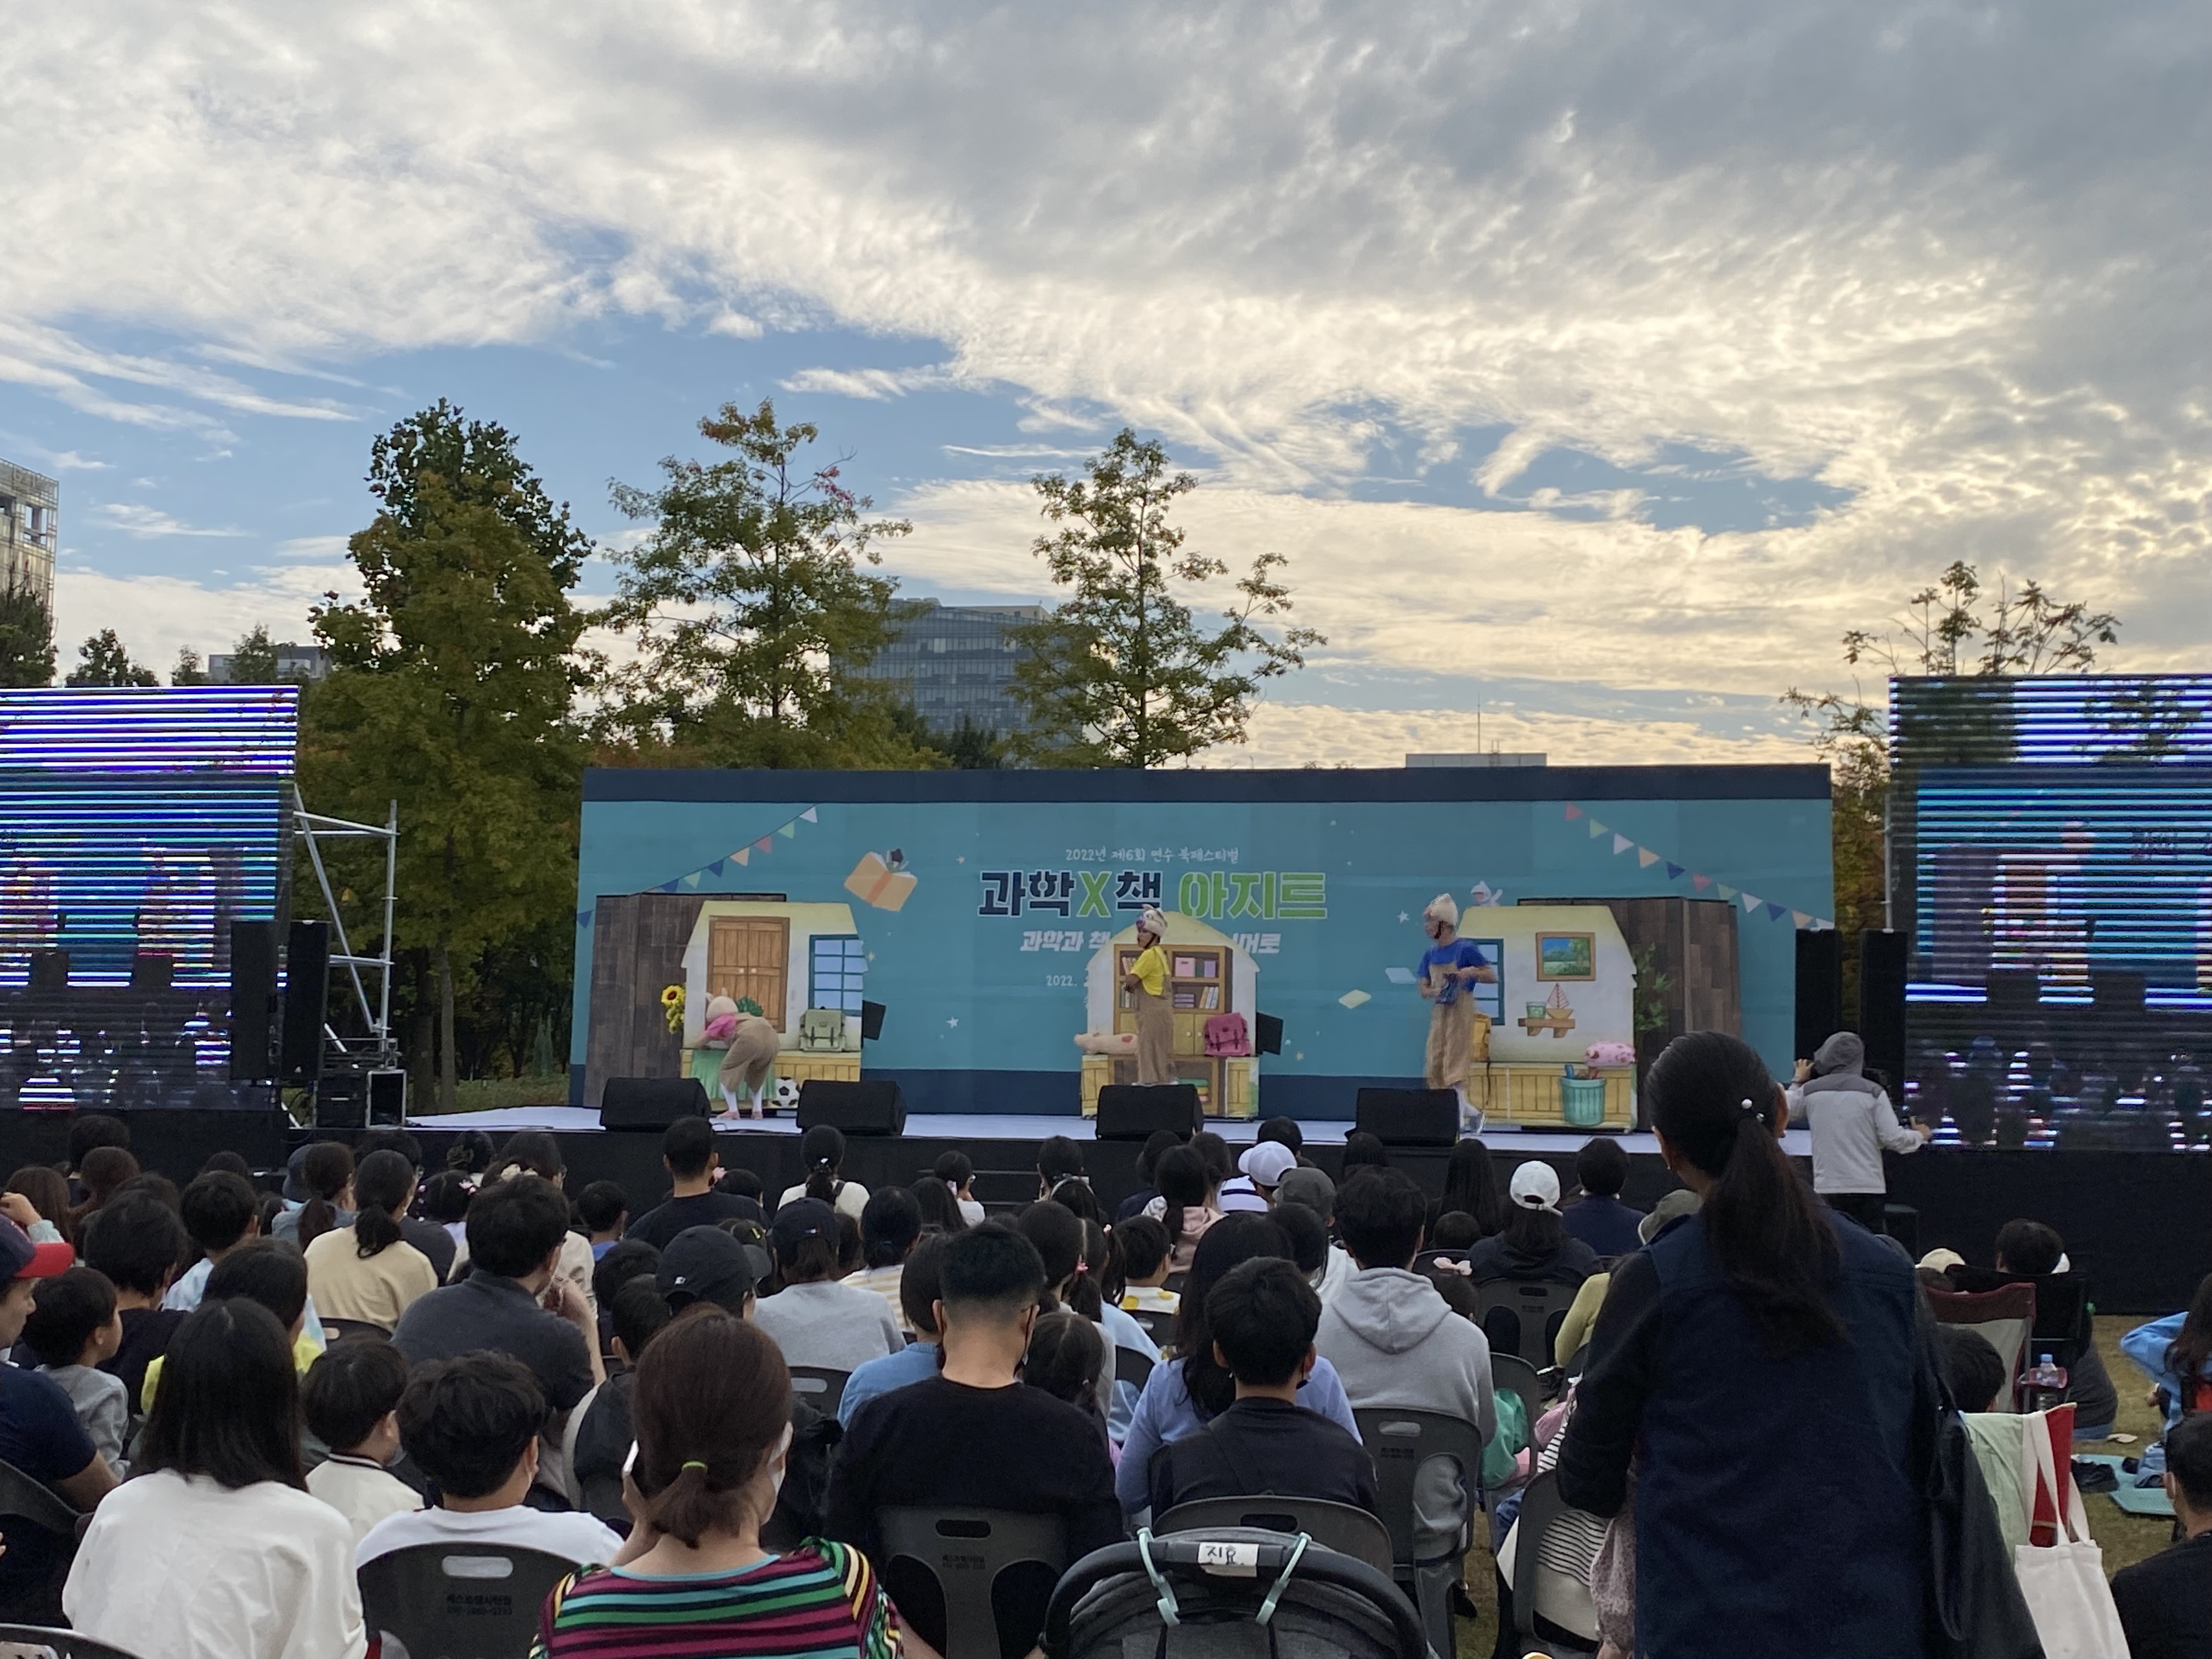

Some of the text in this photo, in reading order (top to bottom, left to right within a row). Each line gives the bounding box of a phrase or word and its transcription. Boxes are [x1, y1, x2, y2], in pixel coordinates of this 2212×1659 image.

[1065, 846, 1239, 864] 2022년 제6회 연수 북페스티벌
[1178, 871, 1328, 920] 아지트
[1020, 930, 1084, 952] 과학과
[1232, 932, 1282, 954] 머로
[1046, 975, 1078, 987] 2022.
